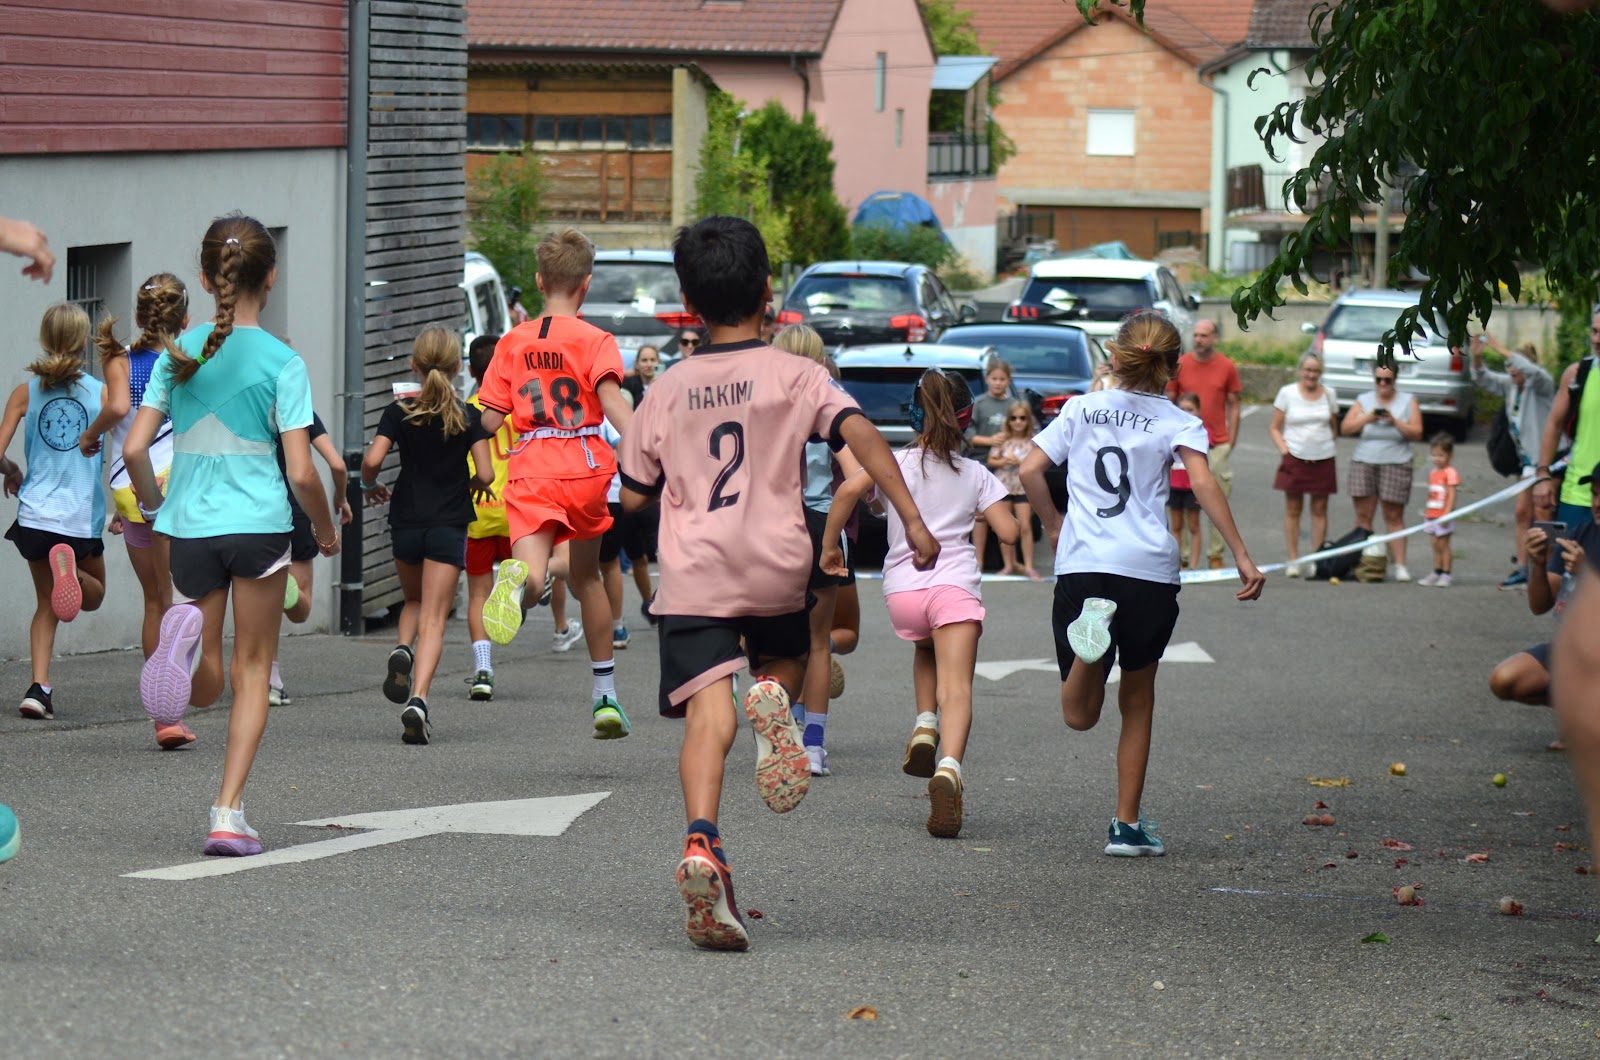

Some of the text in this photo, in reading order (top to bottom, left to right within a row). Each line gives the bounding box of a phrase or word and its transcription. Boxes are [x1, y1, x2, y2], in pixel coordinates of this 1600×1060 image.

[524, 351, 564, 371] ICARDI
[517, 376, 585, 429] 18
[688, 380, 754, 410] HAKIMI
[1081, 407, 1159, 433] MBAPPÉ
[707, 421, 745, 512] 2
[1094, 446, 1131, 518] 9
